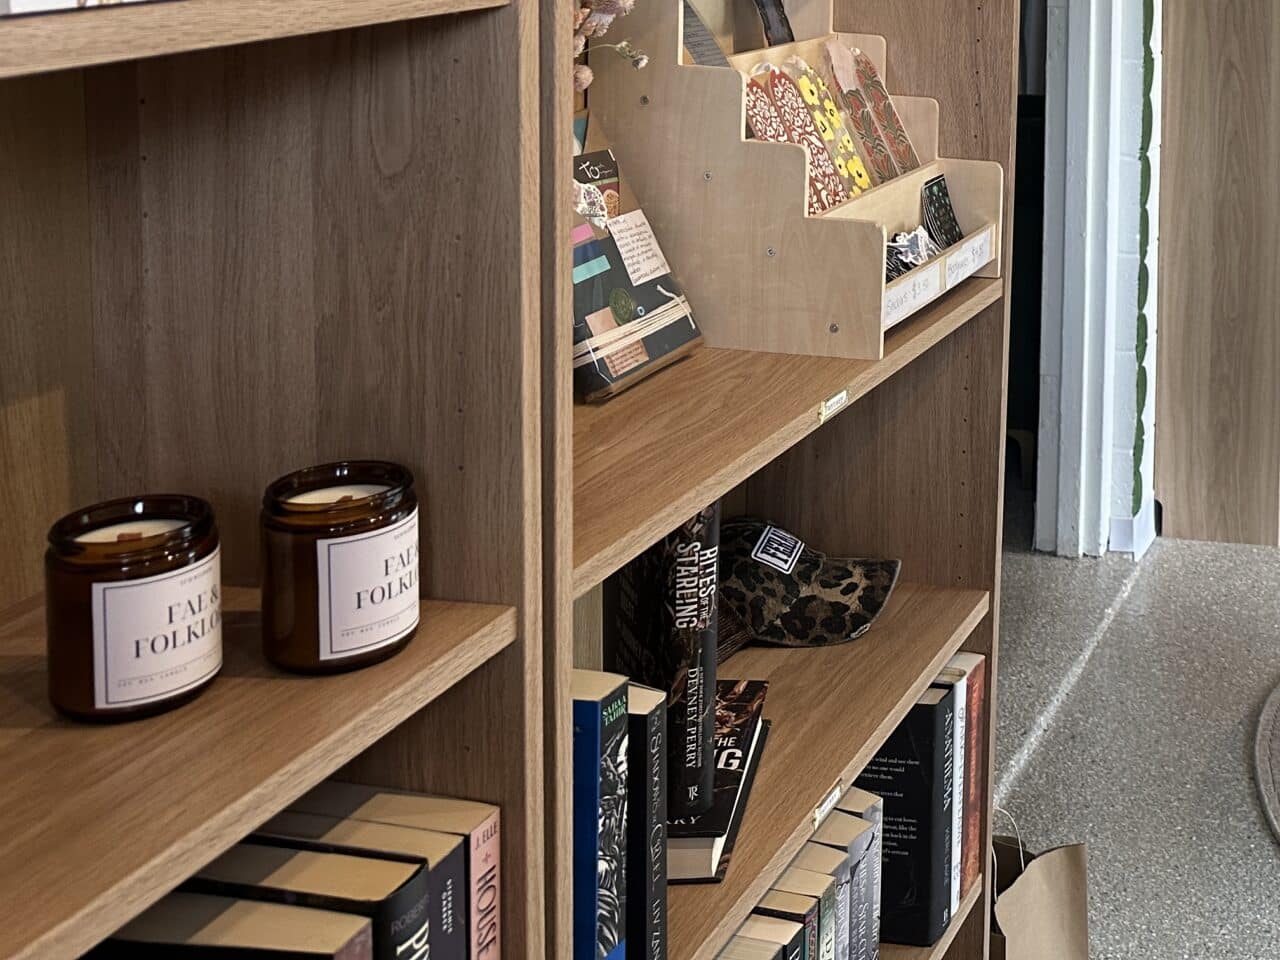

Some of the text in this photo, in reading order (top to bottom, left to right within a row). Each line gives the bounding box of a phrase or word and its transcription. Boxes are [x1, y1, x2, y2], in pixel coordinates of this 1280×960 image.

[384, 546, 413, 577] FAE
[675, 542, 701, 629] STARLING
[699, 545, 719, 598] RITES
[167, 593, 209, 626] FAE
[685, 667, 699, 769] DEVNEY PERRY
[942, 707, 953, 812] ANATHEMA
[482, 820, 498, 844] ELLE
